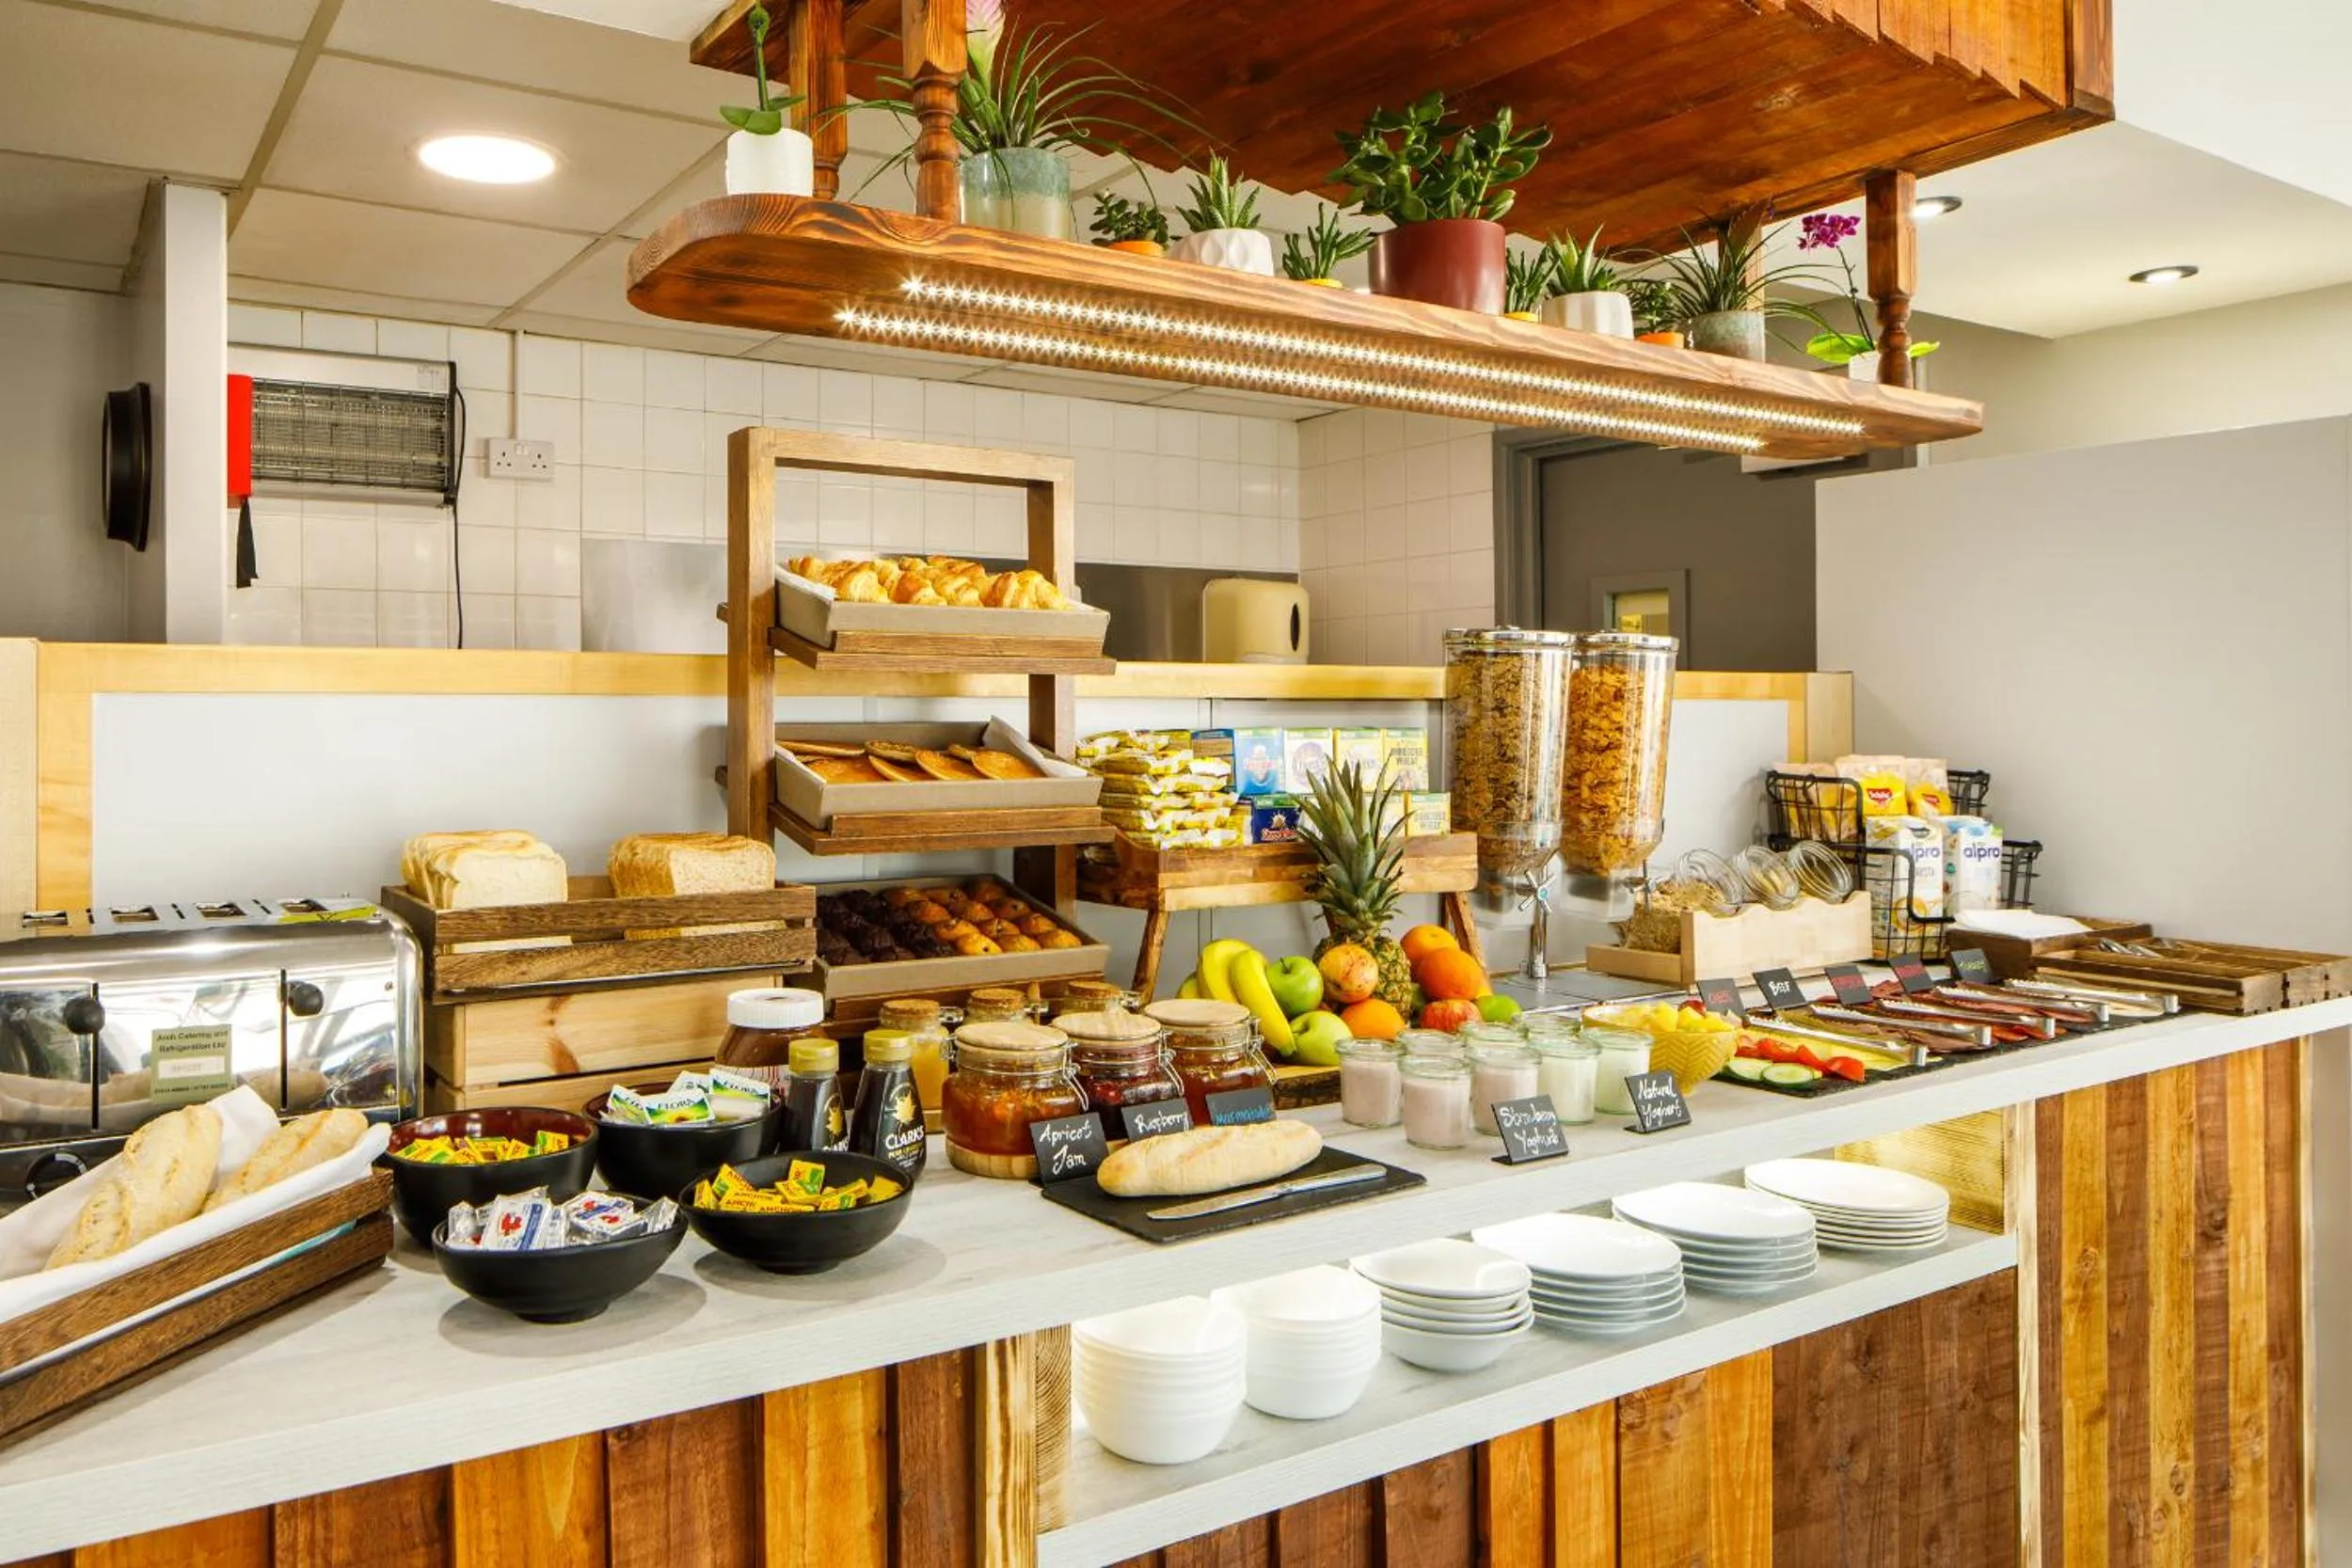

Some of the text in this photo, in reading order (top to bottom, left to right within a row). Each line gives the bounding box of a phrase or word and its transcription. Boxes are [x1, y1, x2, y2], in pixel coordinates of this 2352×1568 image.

[1906, 843, 1941, 863] lpro
[1963, 843, 2000, 863] alpro
[1039, 1118, 1092, 1147] Apricot
[1053, 1145, 1088, 1175] Jam
